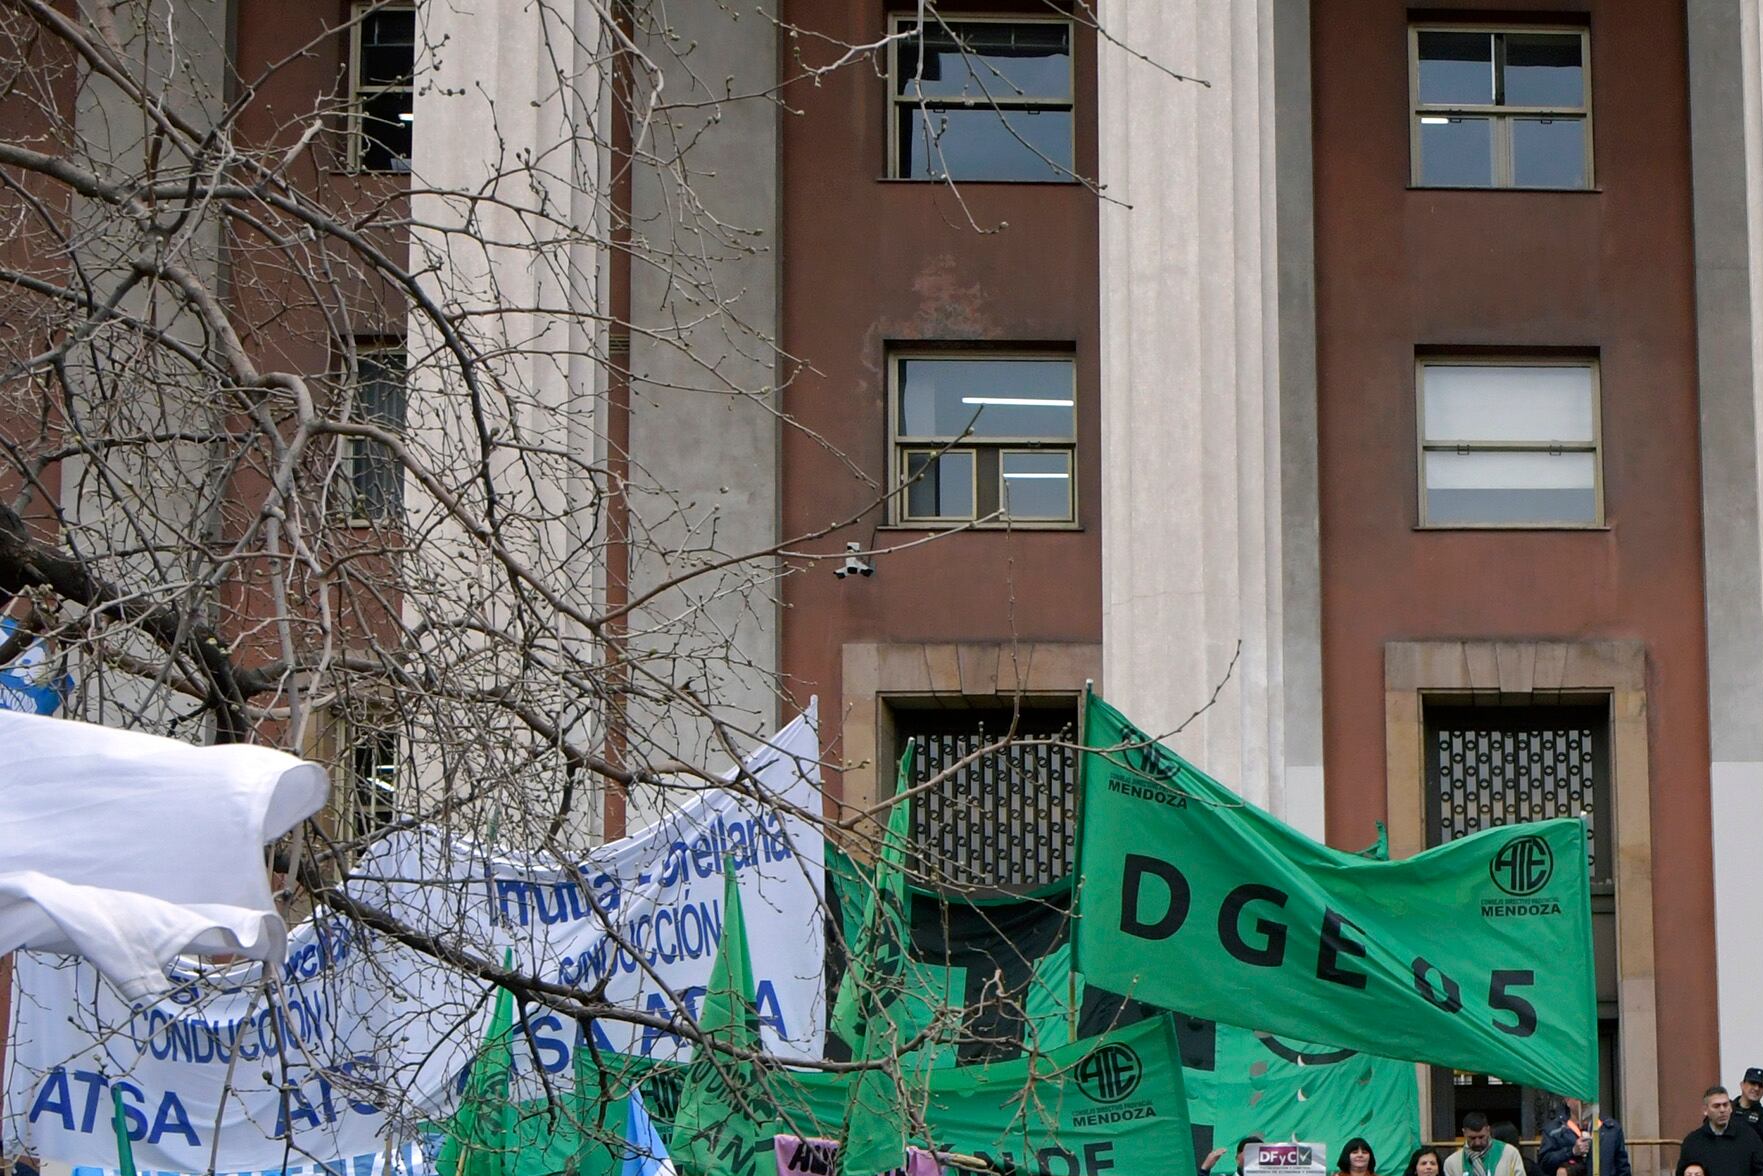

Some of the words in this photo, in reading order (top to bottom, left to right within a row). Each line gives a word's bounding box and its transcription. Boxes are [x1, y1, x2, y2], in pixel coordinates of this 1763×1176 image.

[1107, 779, 1188, 810] MENDOZA
[1494, 838, 1548, 892] ATE
[1481, 903, 1562, 917] MENDOZA
[1079, 1045, 1137, 1099] ATE
[29, 1066, 202, 1147] ATSA
[1072, 1106, 1157, 1128] MENDOZA
[1259, 1151, 1297, 1166] DFyC
